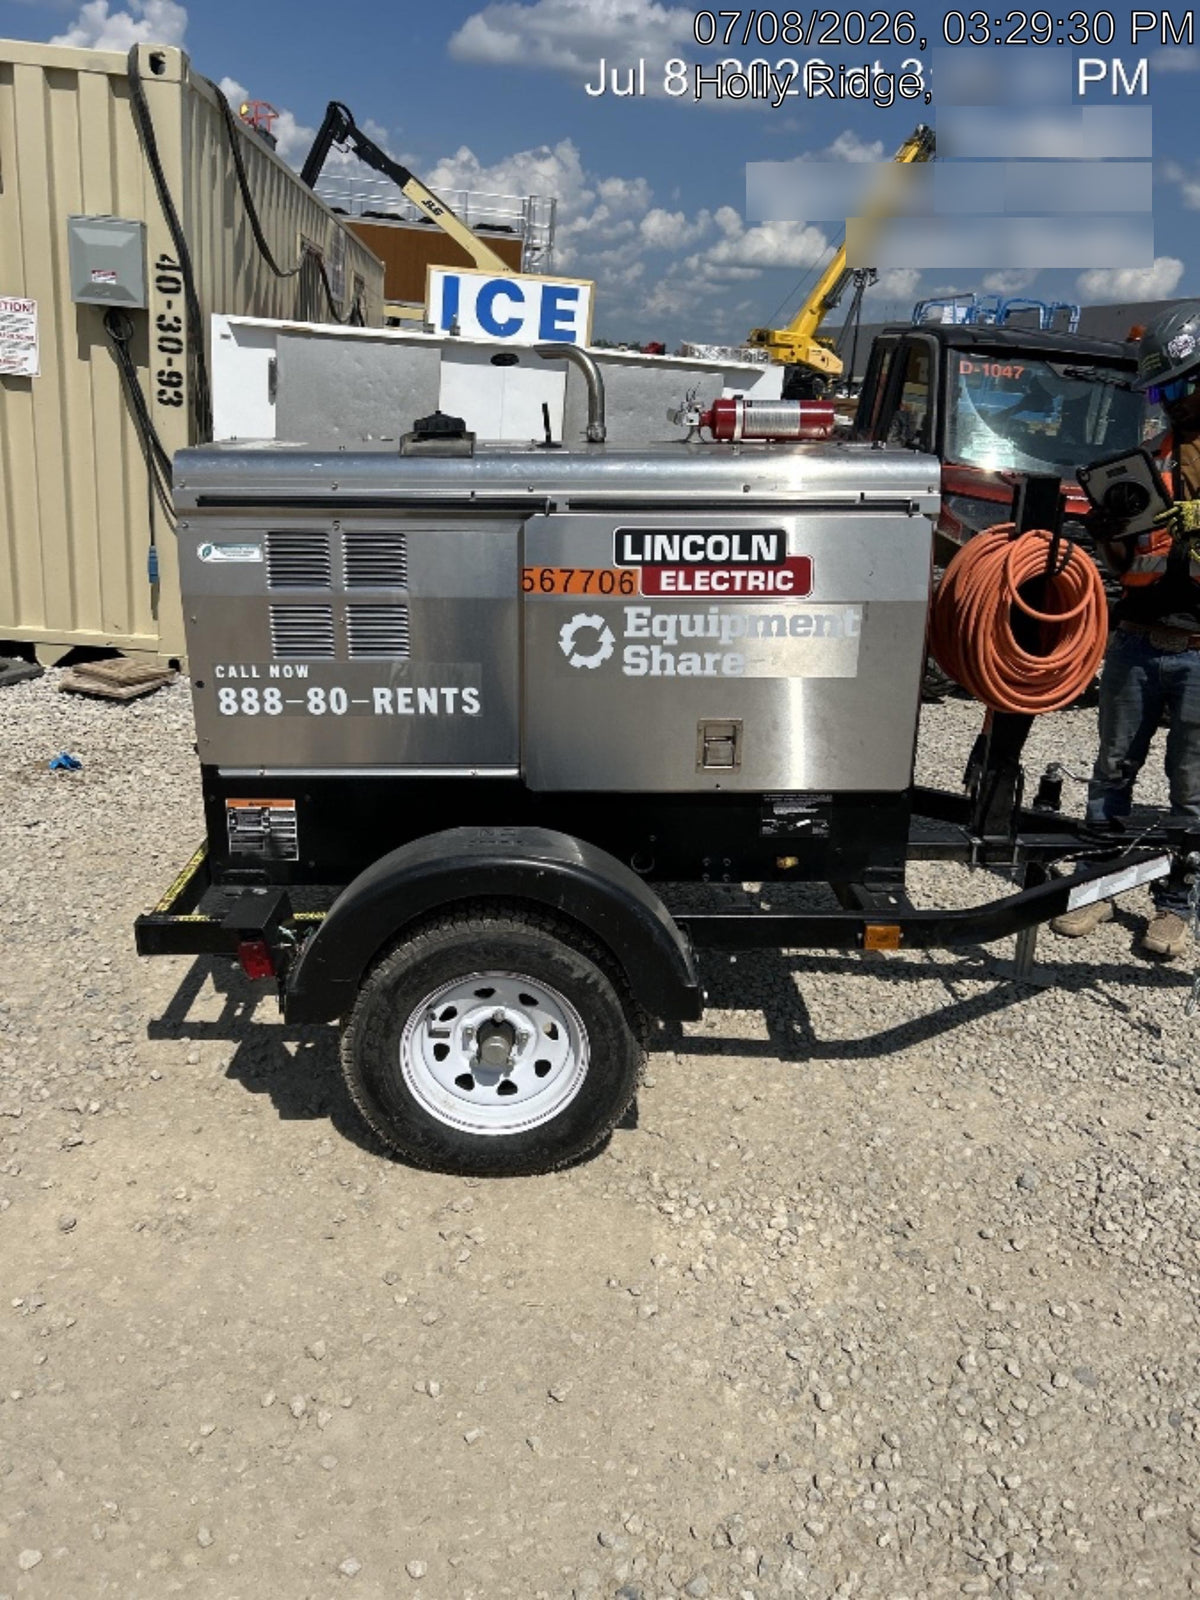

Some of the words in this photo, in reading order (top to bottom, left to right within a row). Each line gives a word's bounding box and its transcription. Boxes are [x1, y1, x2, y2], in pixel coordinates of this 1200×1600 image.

[421, 200, 445, 216] JLG
[0, 301, 32, 314] TION
[441, 275, 580, 343] ICE
[155, 254, 184, 408] 40-30-93
[959, 360, 1025, 379] D-1047
[623, 534, 779, 562] LINCOLN
[521, 568, 634, 595] 567706
[659, 570, 795, 592] ELECTRIC
[622, 606, 862, 646] Equipment
[214, 664, 261, 679] CALL
[269, 665, 310, 679] NOW
[622, 644, 746, 677] Share
[217, 686, 482, 716] 888-80-RENTS
